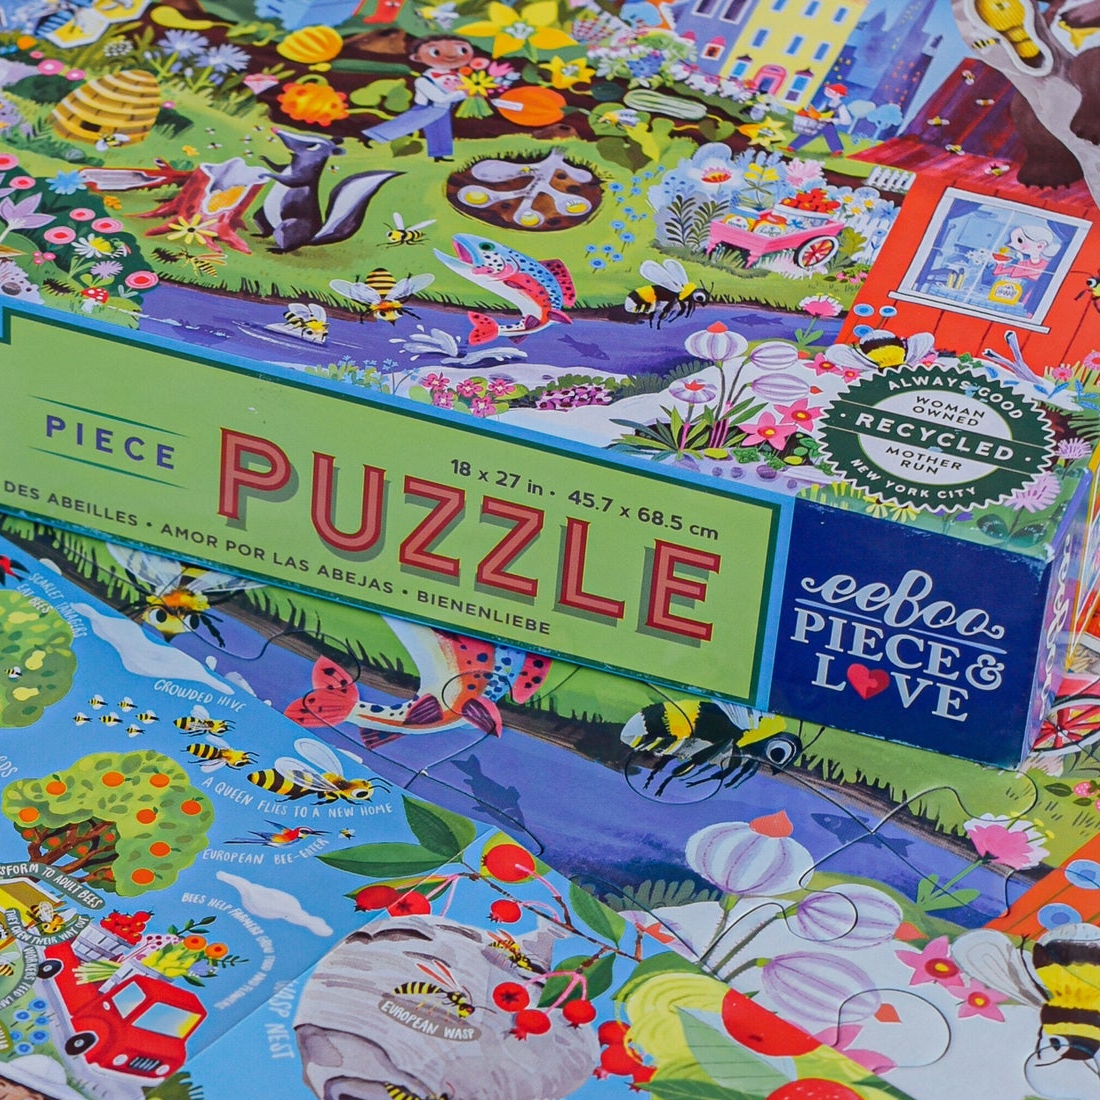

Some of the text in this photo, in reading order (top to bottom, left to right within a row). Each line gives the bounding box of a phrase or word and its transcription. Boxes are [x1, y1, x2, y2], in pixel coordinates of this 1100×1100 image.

[888, 375, 1024, 420] ALWAYS GOOD
[912, 405, 979, 427] OWNED
[916, 395, 985, 418] WOMAN
[46, 414, 175, 470] PIECE
[855, 413, 1014, 462] RECYCLED
[885, 446, 963, 471] MOTHER
[850, 457, 977, 500] NEW YORK CITY
[900, 460, 939, 475] RUN
[4, 480, 40, 501] DES
[47, 492, 139, 527] ABEILLES
[451, 458, 719, 541] 18 x 27 in 45.7 x 68.5 cm
[217, 427, 722, 643] PUZZLE
[160, 522, 395, 595] AMOR POR LAS ABEJAS
[28, 597, 54, 614] BEES
[417, 590, 551, 636] BIENENLIEBE
[801, 570, 1005, 640] eeboo
[790, 607, 1005, 691] PIECE &
[153, 678, 247, 712] CROWDED HIVE
[201, 776, 393, 818] A QUEEN FLIES TO A NEW HOME
[202, 837, 330, 865] EUROPEAN BEE-EATER
[42, 866, 56, 878] TO
[54, 873, 81, 895] ADULT
[78, 889, 104, 909] BEES
[181, 892, 206, 904] BEES
[207, 898, 233, 912] HELP
[265, 980, 298, 1059] WASP NEST
[381, 1000, 475, 1040] EUROPEAN WASP
